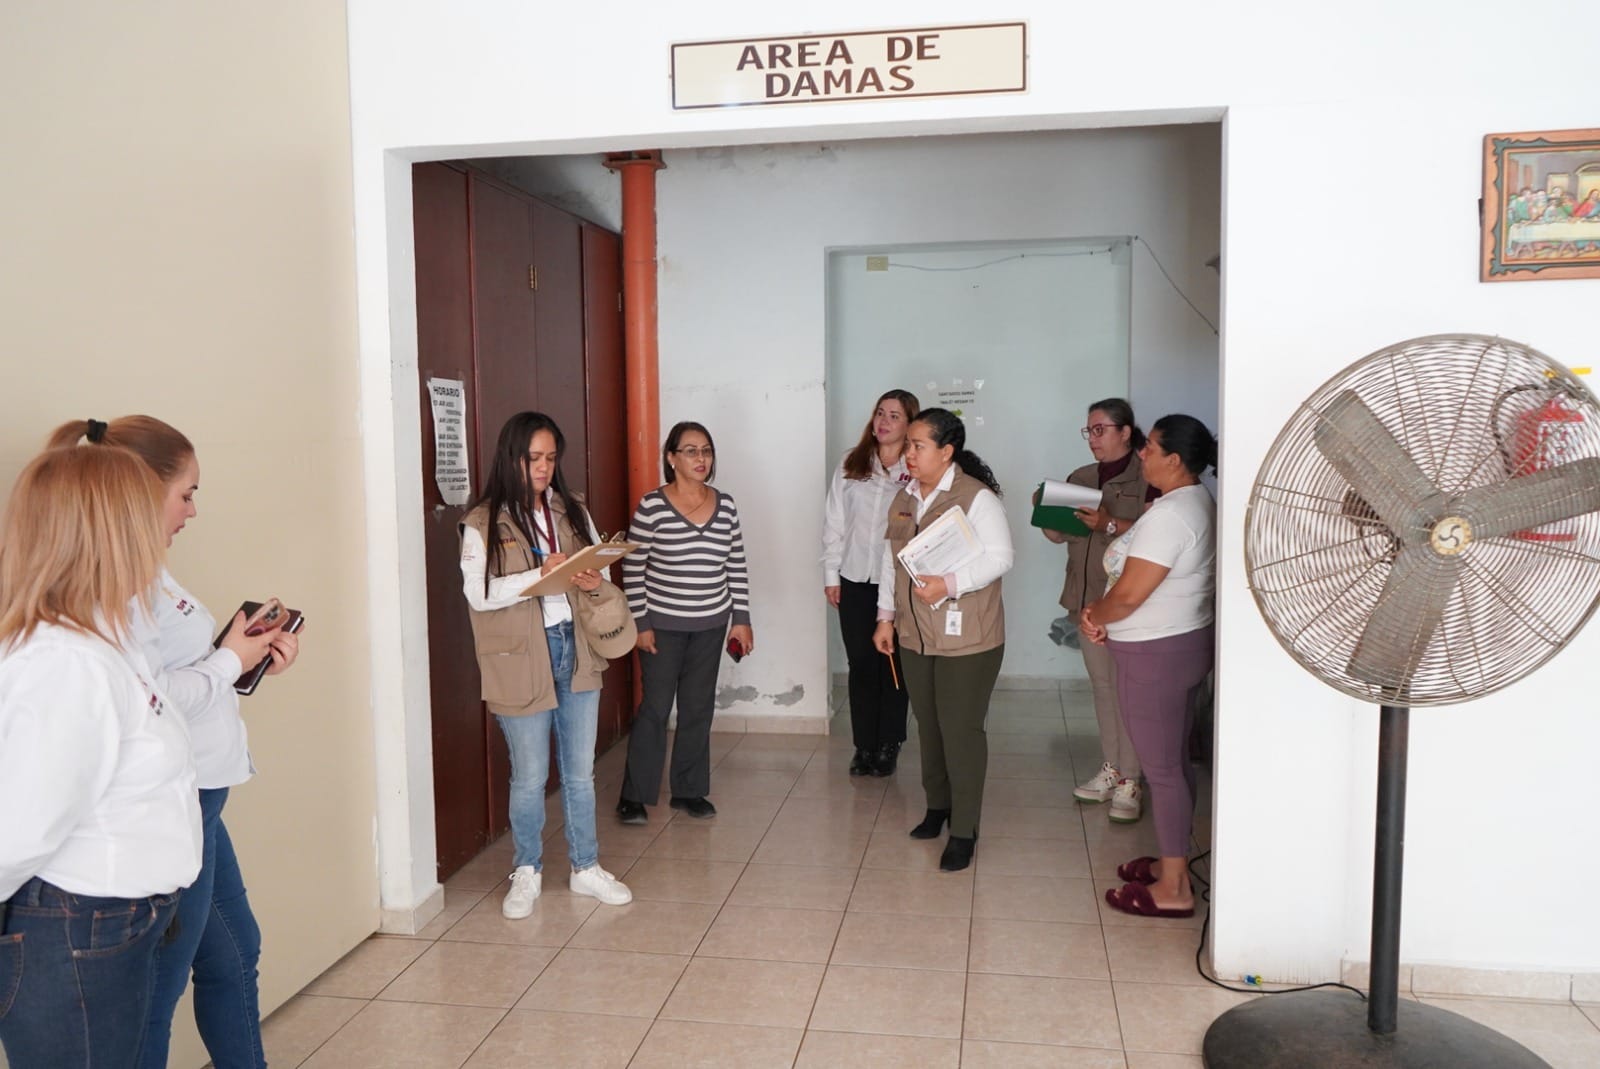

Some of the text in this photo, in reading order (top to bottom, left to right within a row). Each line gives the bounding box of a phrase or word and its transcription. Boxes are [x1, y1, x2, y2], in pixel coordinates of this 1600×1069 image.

[736, 34, 941, 71] AREA DE
[765, 65, 915, 98] DAMAS
[433, 386, 460, 398] HORARIO
[599, 625, 625, 641] PUMA
